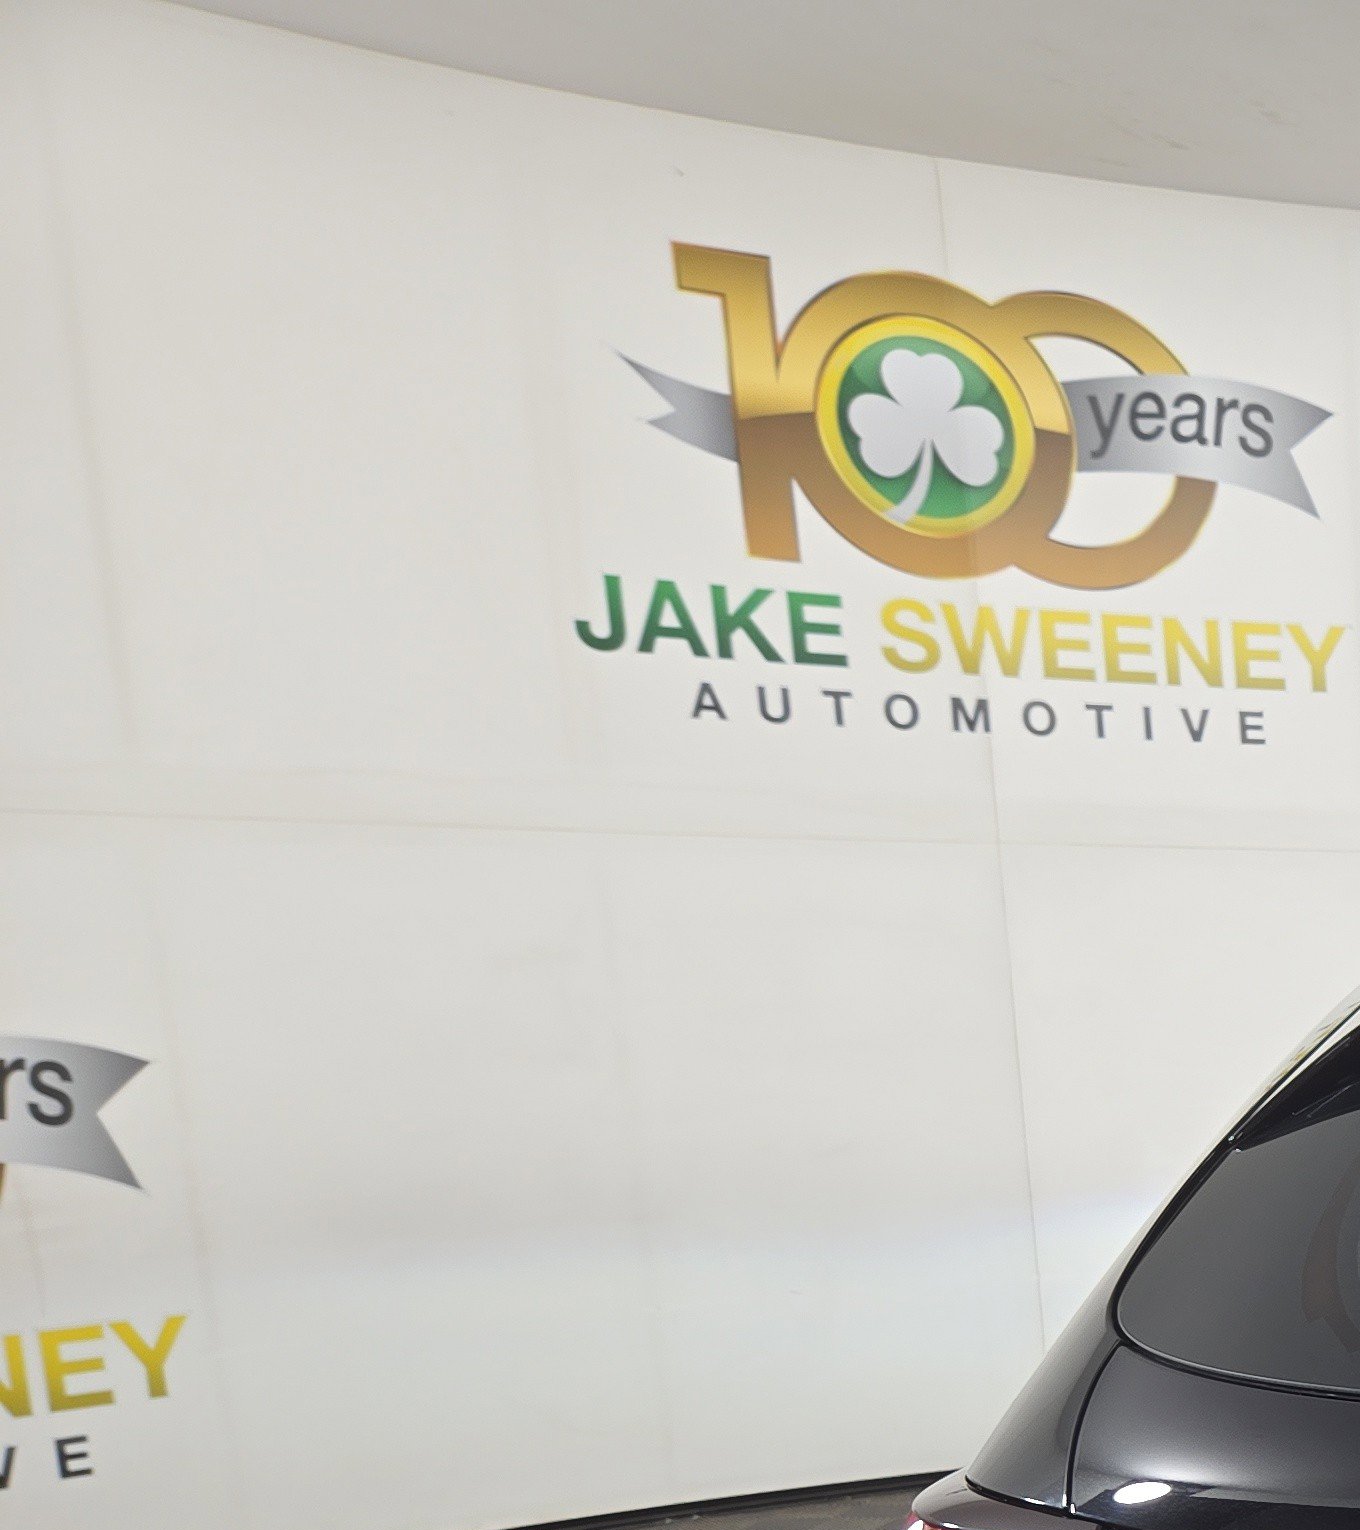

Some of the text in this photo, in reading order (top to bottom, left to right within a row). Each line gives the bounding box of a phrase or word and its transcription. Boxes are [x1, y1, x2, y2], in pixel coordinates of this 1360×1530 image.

[1087, 390, 1275, 458] years
[575, 574, 1345, 693] JAKE SWEENEY
[692, 681, 1267, 745] AUTOMOTIVE
